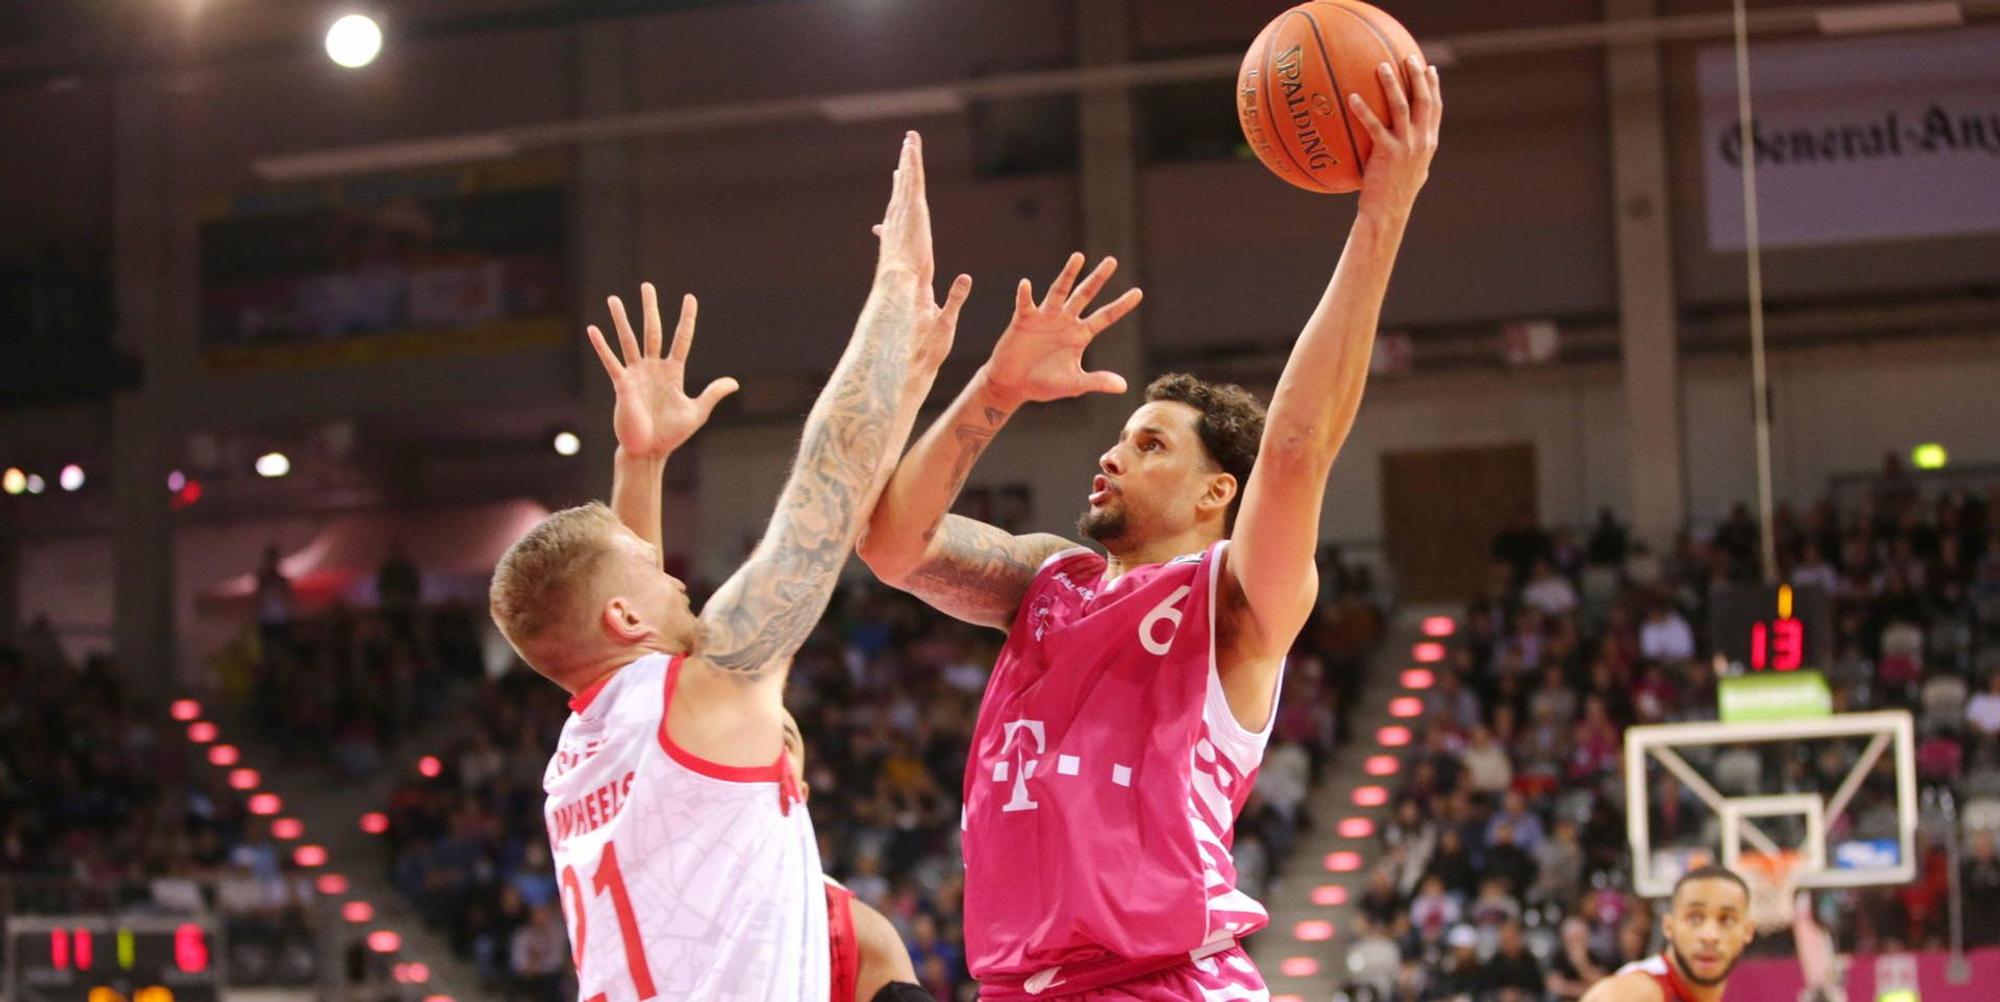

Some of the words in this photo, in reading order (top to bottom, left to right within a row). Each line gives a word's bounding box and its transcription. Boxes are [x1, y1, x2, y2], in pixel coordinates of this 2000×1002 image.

[1274, 44, 1339, 171] SPALDING
[1719, 103, 2000, 168] General-An
[1138, 585, 1193, 656] 6
[1751, 618, 1804, 672] 13
